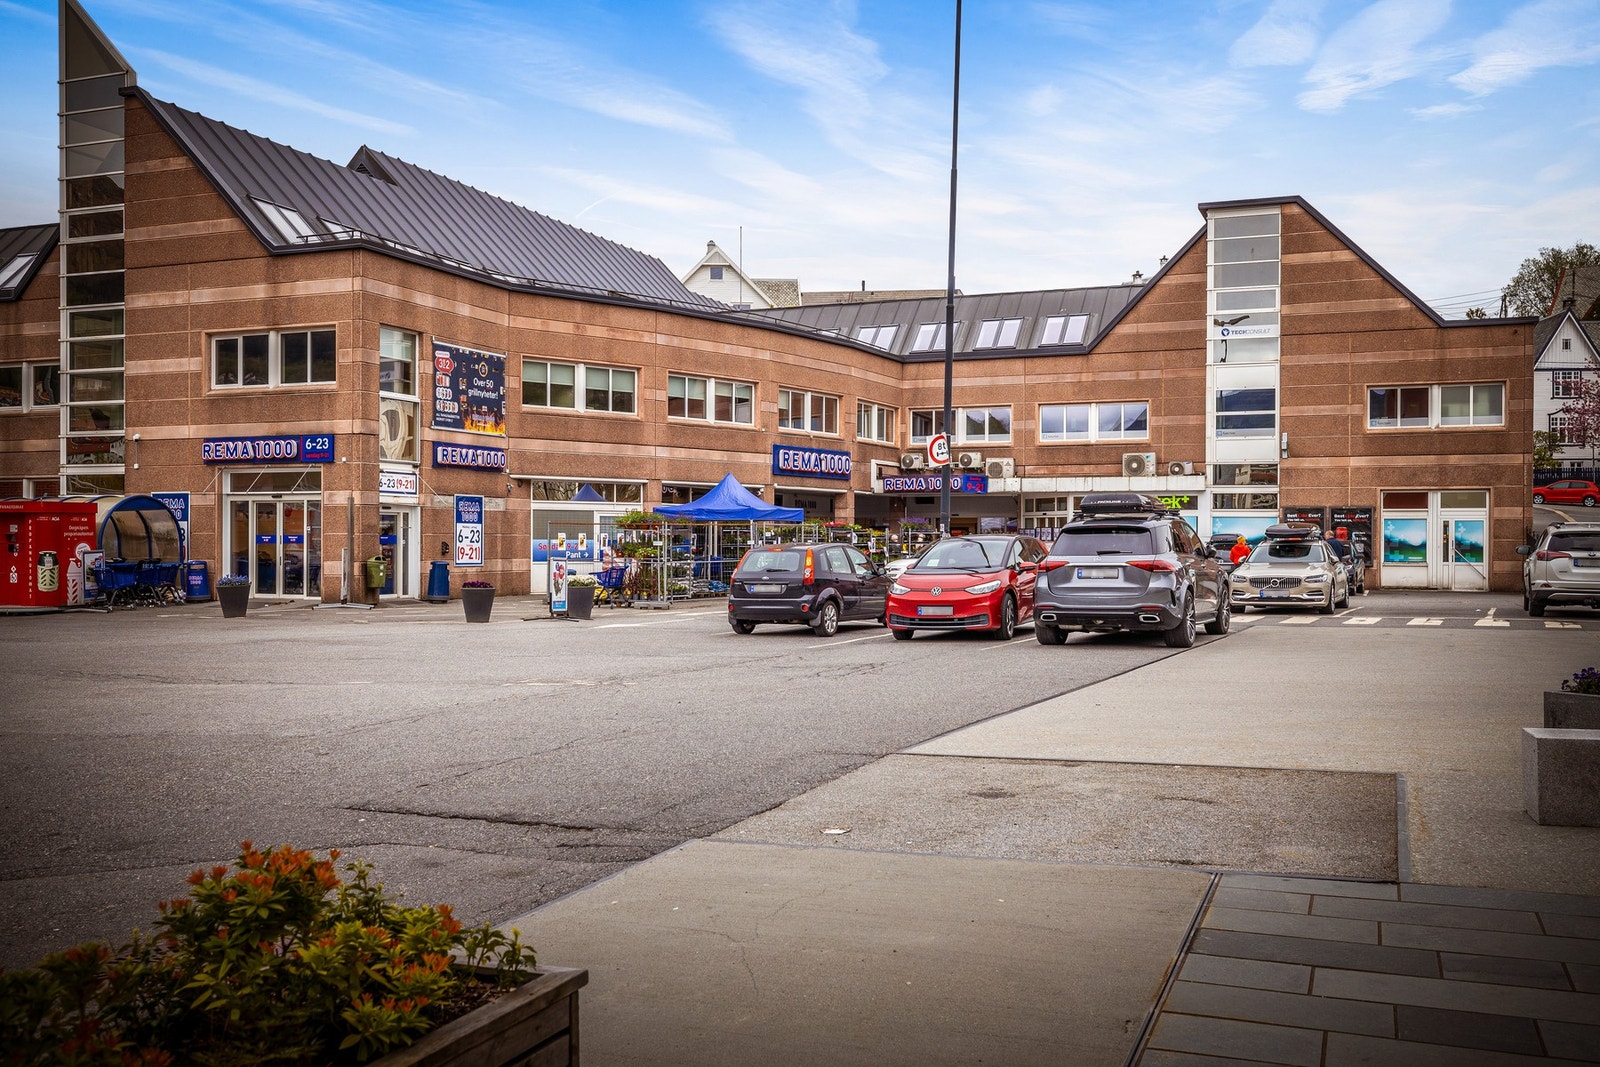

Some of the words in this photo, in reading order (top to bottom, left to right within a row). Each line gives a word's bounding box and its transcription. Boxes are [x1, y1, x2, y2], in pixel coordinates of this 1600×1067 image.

[473, 377, 486, 386] Over
[486, 380, 494, 388] 50
[202, 441, 253, 460] REMA
[255, 439, 297, 458] 1000
[305, 438, 329, 449] 6-23
[439, 447, 478, 466] REMA
[478, 450, 506, 468] 1000
[779, 449, 820, 472] REMA
[821, 453, 852, 474] 1000
[379, 478, 396, 488] 6-23
[396, 478, 414, 490] (9-21)
[884, 478, 926, 490] REMA
[928, 477, 961, 490] 100
[966, 482, 984, 492] 9-21
[458, 501, 480, 512] REMA
[461, 512, 478, 522] 1000
[458, 530, 480, 543] 6-23
[458, 546, 480, 561] (9-21)
[566, 551, 582, 559] Pant
